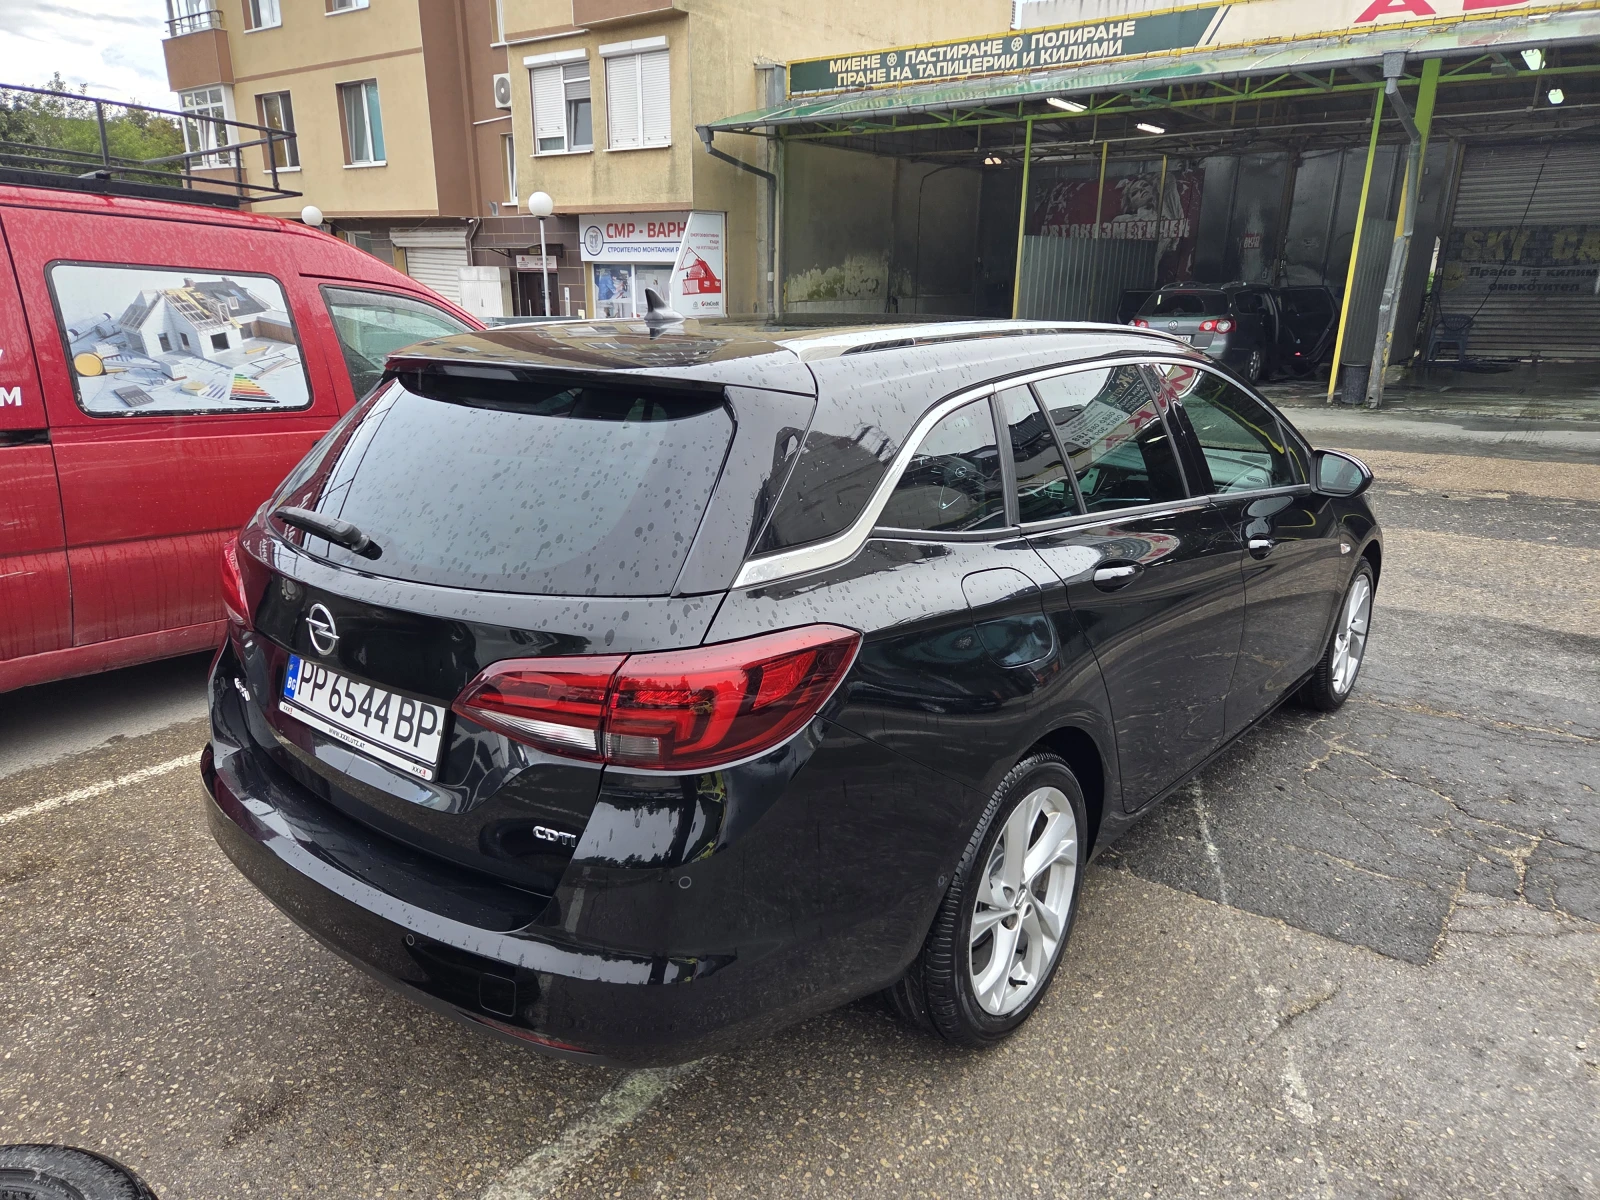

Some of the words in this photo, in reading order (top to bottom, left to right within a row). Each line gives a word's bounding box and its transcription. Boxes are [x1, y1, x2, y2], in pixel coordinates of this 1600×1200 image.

[829, 55, 880, 73] МИЕНЕ
[905, 40, 1003, 64] ПАСТИРАНЕ
[1031, 20, 1136, 49] ПОЛИРАНЕ
[837, 68, 887, 86] ПРАНЕ
[890, 66, 912, 81] НА
[917, 53, 1017, 78] ТАПИЦЕРИИ
[1022, 51, 1035, 66] И
[1040, 39, 1123, 64] КИЛИМИ
[606, 222, 635, 239] СМР
[1461, 229, 1531, 261] SKY
[1469, 267, 1517, 278] Пране
[1521, 269, 1541, 277] на
[1488, 282, 1580, 292] омекотител
[287, 676, 297, 691] BG
[298, 661, 328, 701] PP
[329, 675, 389, 735] 6544
[393, 696, 438, 748] BP
